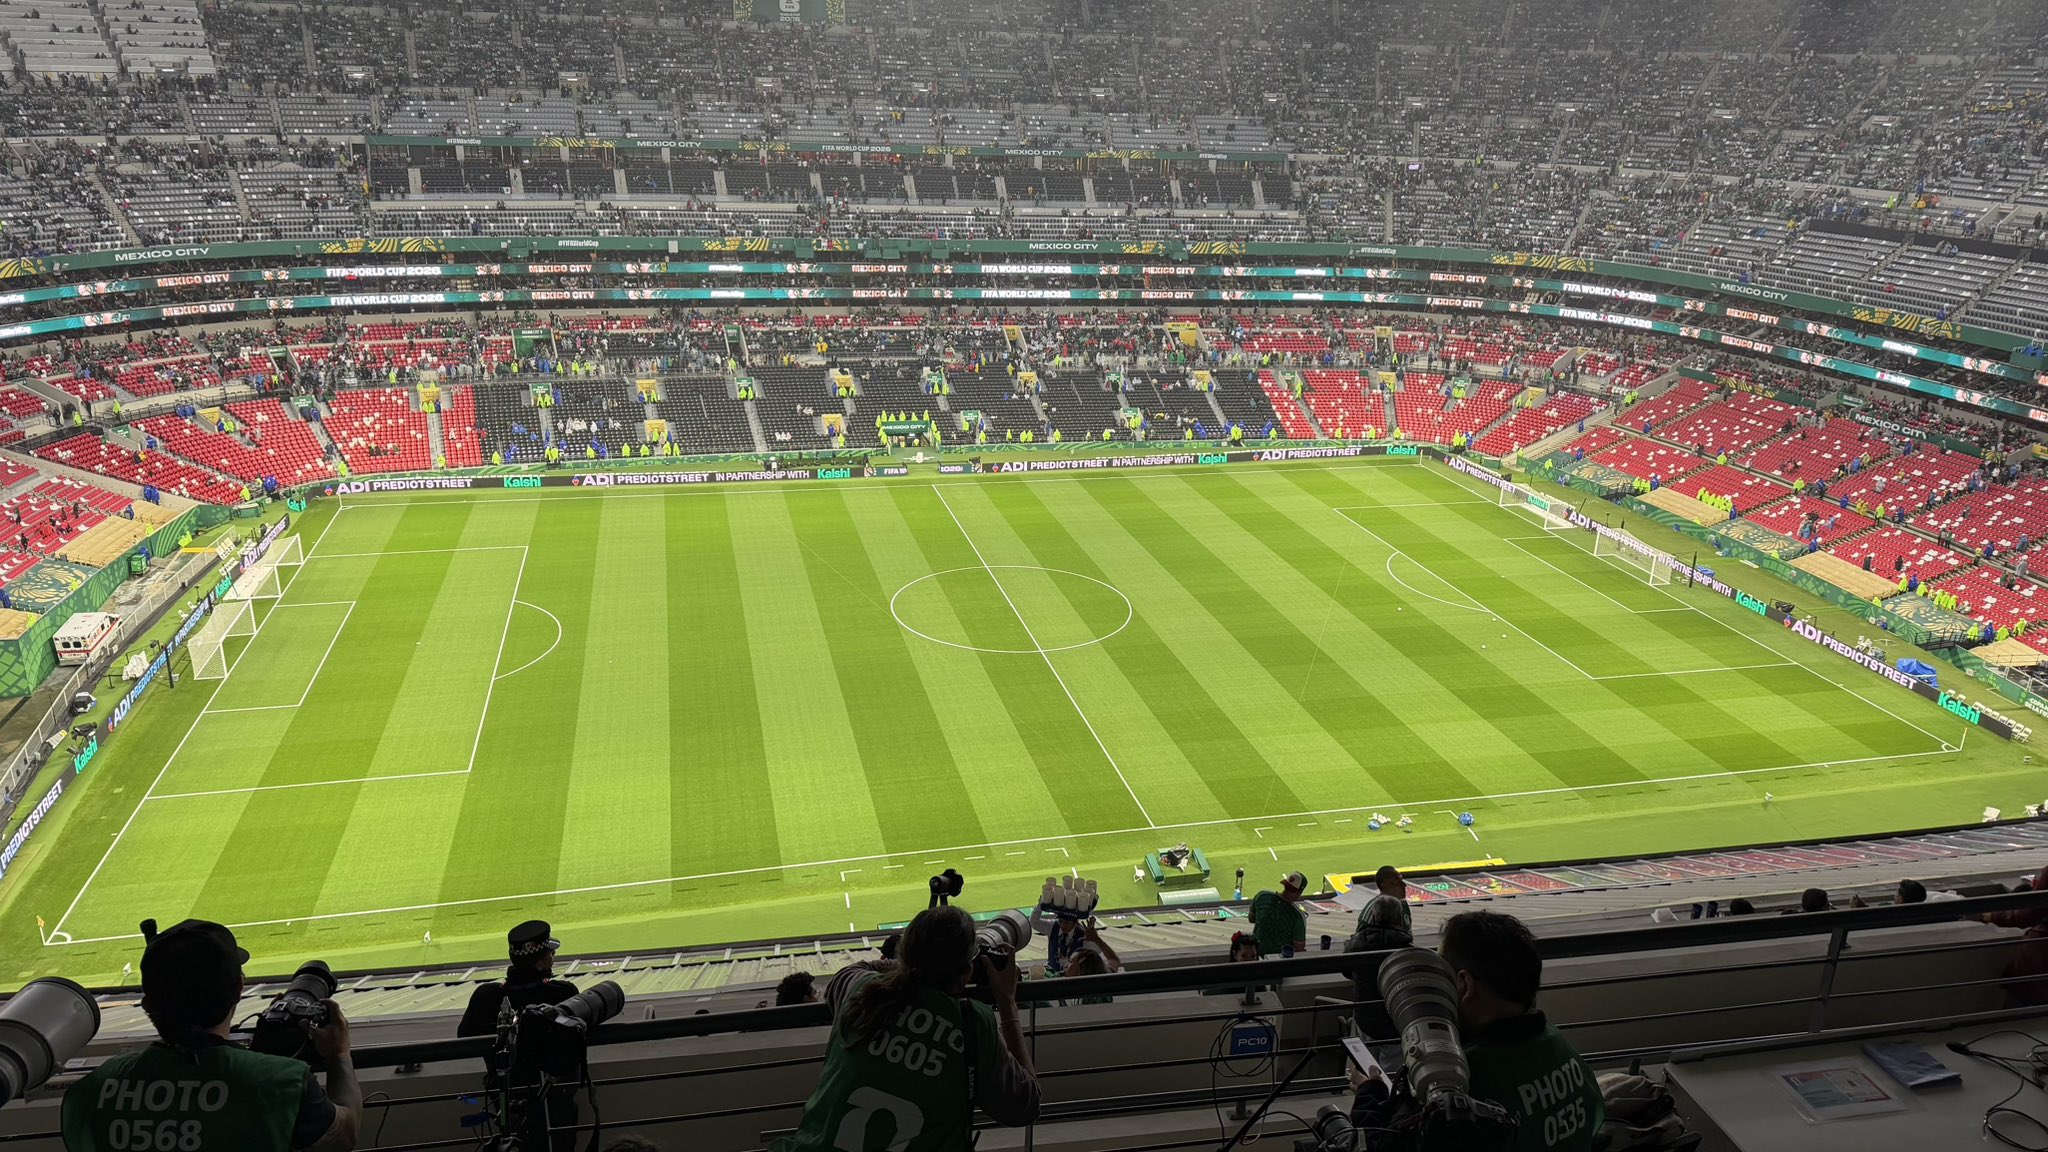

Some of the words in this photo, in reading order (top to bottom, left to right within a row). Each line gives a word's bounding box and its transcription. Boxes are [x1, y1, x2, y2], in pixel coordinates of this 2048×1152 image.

[558, 240, 599, 248] #FIFAWorldCup
[115, 250, 173, 261] MEXICO
[176, 248, 210, 257] CITY
[326, 268, 349, 277] FIFA
[350, 267, 385, 277] WORLD
[386, 267, 407, 276] CUP
[408, 266, 442, 275] 2026
[529, 265, 568, 273] MEXICO
[570, 265, 593, 273] CITY
[852, 265, 887, 273] MEXICO
[888, 265, 908, 273] CITY
[981, 265, 999, 274] FIFA
[1000, 265, 1027, 274] WORLD
[1027, 265, 1044, 274] CUP
[1044, 265, 1072, 274] 2026
[1142, 266, 1174, 274] MEXICO
[1174, 266, 1196, 275] CITY
[157, 276, 201, 288] MEXICO
[204, 273, 231, 283] CITY
[1430, 273, 1465, 282] MEXICO
[1466, 274, 1487, 284] CITY
[331, 297, 353, 306] FIFA
[353, 296, 389, 305] WORLD
[389, 295, 409, 304] CUP
[410, 294, 446, 303] 2026
[532, 291, 570, 299] MEXICO
[572, 291, 595, 299] CITY
[853, 290, 887, 298] MEXICO
[981, 290, 999, 299] FIFA
[1000, 290, 1027, 299] WORLD
[1027, 290, 1044, 299] CUP
[1044, 290, 1071, 299] 2026
[1142, 291, 1173, 299] MEXICO
[1174, 291, 1194, 299] CITY
[1563, 283, 1581, 292] FIFA
[1582, 285, 1611, 296] WORLD
[1628, 292, 1657, 303] 2026
[1721, 283, 1762, 296] MEXICO
[1763, 290, 1788, 301] CITY
[163, 304, 208, 317] MEXICO
[210, 302, 236, 313] CITY
[1463, 299, 1484, 308] CITY
[1560, 309, 1577, 318] FIFA
[1608, 314, 1624, 324] CUP
[1624, 318, 1653, 329] 2026
[1726, 308, 1760, 321] MEXICO
[1761, 314, 1780, 325] CITY
[1721, 335, 1753, 349] MEXICO
[1754, 342, 1774, 353] CITY
[1855, 413, 1900, 432] MEXICO
[1260, 450, 1286, 461] ADI
[1386, 444, 1417, 455] Kalshi
[1001, 461, 1028, 472] ADI
[1030, 460, 1109, 470] PREDICTSTREET
[1112, 459, 1121, 467] IN
[1121, 456, 1173, 467] PARTNERSHIP
[1174, 456, 1194, 464] WITH
[1448, 458, 1466, 473] ADI
[582, 474, 614, 486] ADI
[617, 474, 709, 484] PREDICTSTREET
[716, 472, 725, 481] IN
[726, 470, 786, 481] PARTNERSHIP
[788, 470, 810, 479] WITH
[817, 468, 851, 480] Kalshi
[336, 481, 370, 495] ADI
[374, 479, 473, 491] PREDICTSTREET
[504, 476, 543, 488] Kalshi
[1570, 511, 1591, 529] ADI
[1712, 580, 1731, 597] WITH
[1735, 589, 1767, 616] Kalshi
[1790, 620, 1822, 645] ADI
[1822, 634, 1917, 690] PREDICTSTREET
[1938, 691, 1981, 725] Kalshi
[114, 694, 131, 727] ADI
[131, 642, 174, 703] PREDICTSTRET
[74, 735, 98, 775] Kalshi
[0, 778, 62, 870] PREDICTSTREET
[896, 1005, 965, 1054] OTO
[868, 1030, 948, 1077] 0605
[96, 1078, 229, 1112] PHOTO
[1516, 1058, 1584, 1116] PHOTO
[1544, 1096, 1586, 1147] 0535
[109, 1119, 202, 1151] 0568
